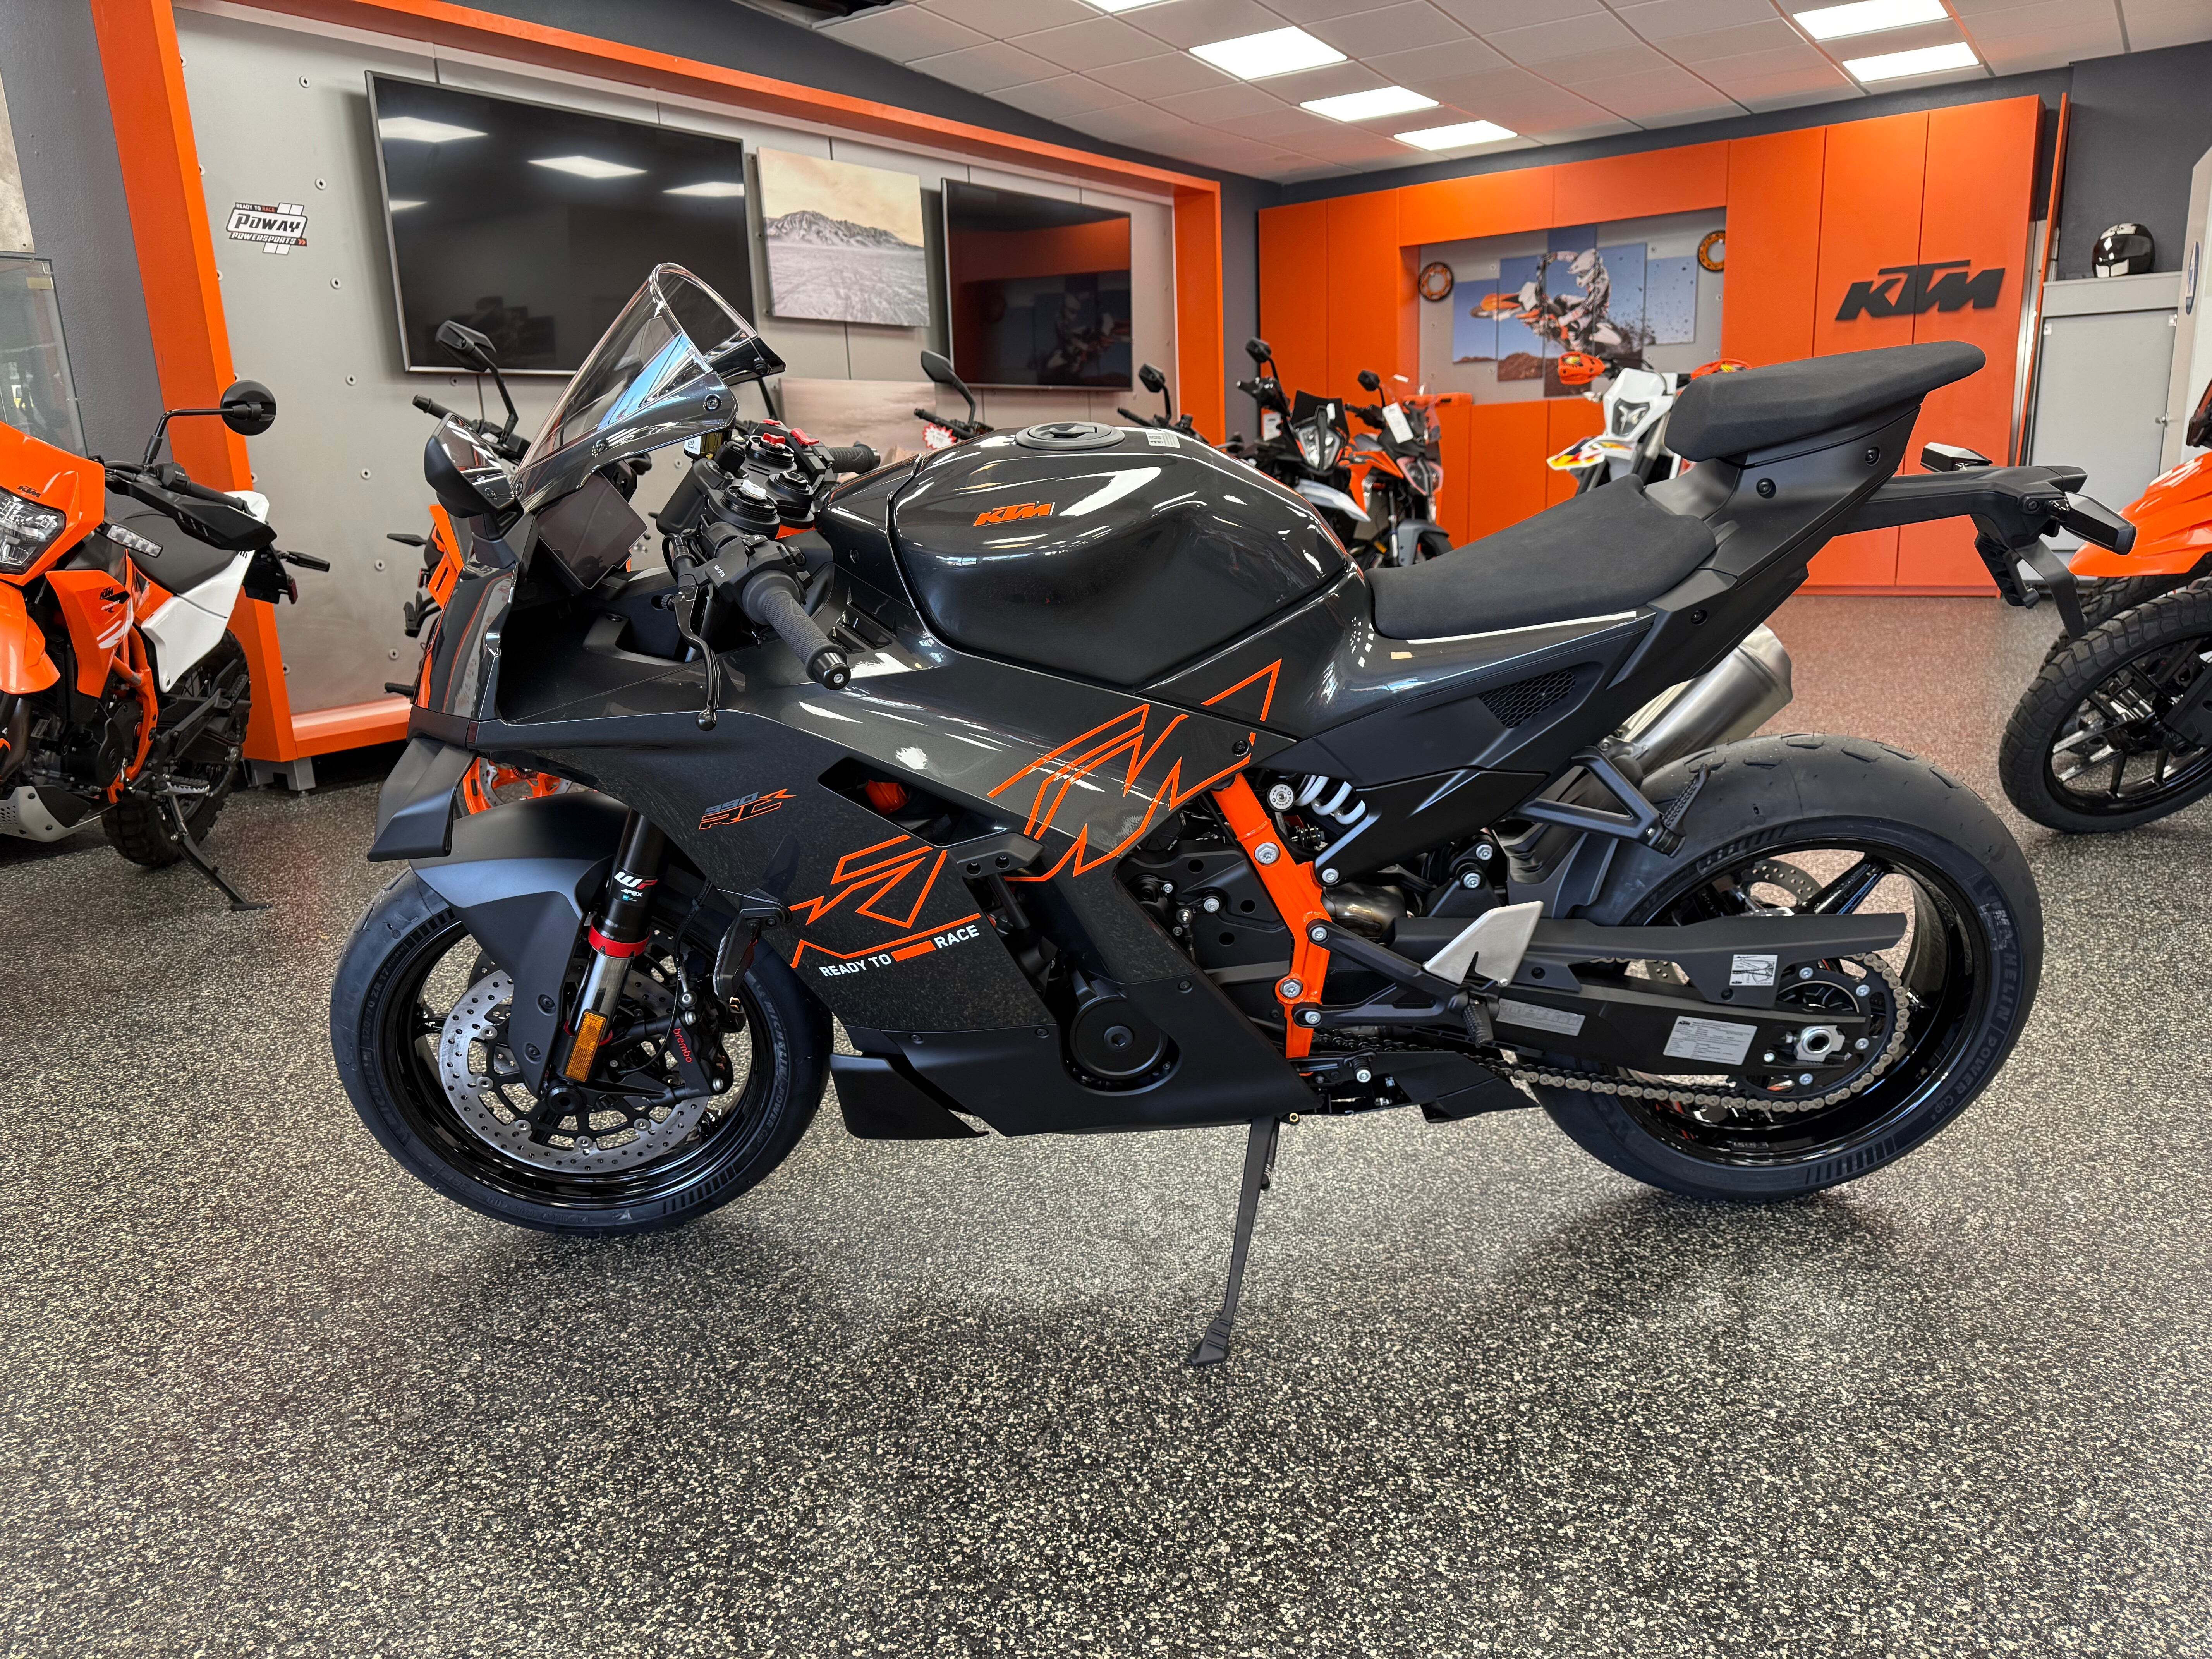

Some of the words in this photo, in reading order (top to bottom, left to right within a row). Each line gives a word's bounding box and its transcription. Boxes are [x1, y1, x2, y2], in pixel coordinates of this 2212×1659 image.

[231, 232, 296, 244] POWERSPORTS
[1835, 260, 2005, 321] KTM
[17, 485, 41, 498] KTM
[973, 503, 1051, 526] KTM
[99, 586, 113, 600] KTM
[699, 799, 782, 830] RC
[704, 792, 759, 815] 990
[614, 872, 658, 889] WP
[621, 889, 643, 897] APEX
[819, 960, 867, 977] READY
[868, 954, 892, 967] TO
[934, 925, 980, 948] RACE
[379, 968, 389, 980] 17
[673, 1028, 692, 1062] brembo
[764, 1001, 788, 1080] MICHELIN
[1954, 1035, 1997, 1094] POWER
[766, 1088, 785, 1127] POWER
